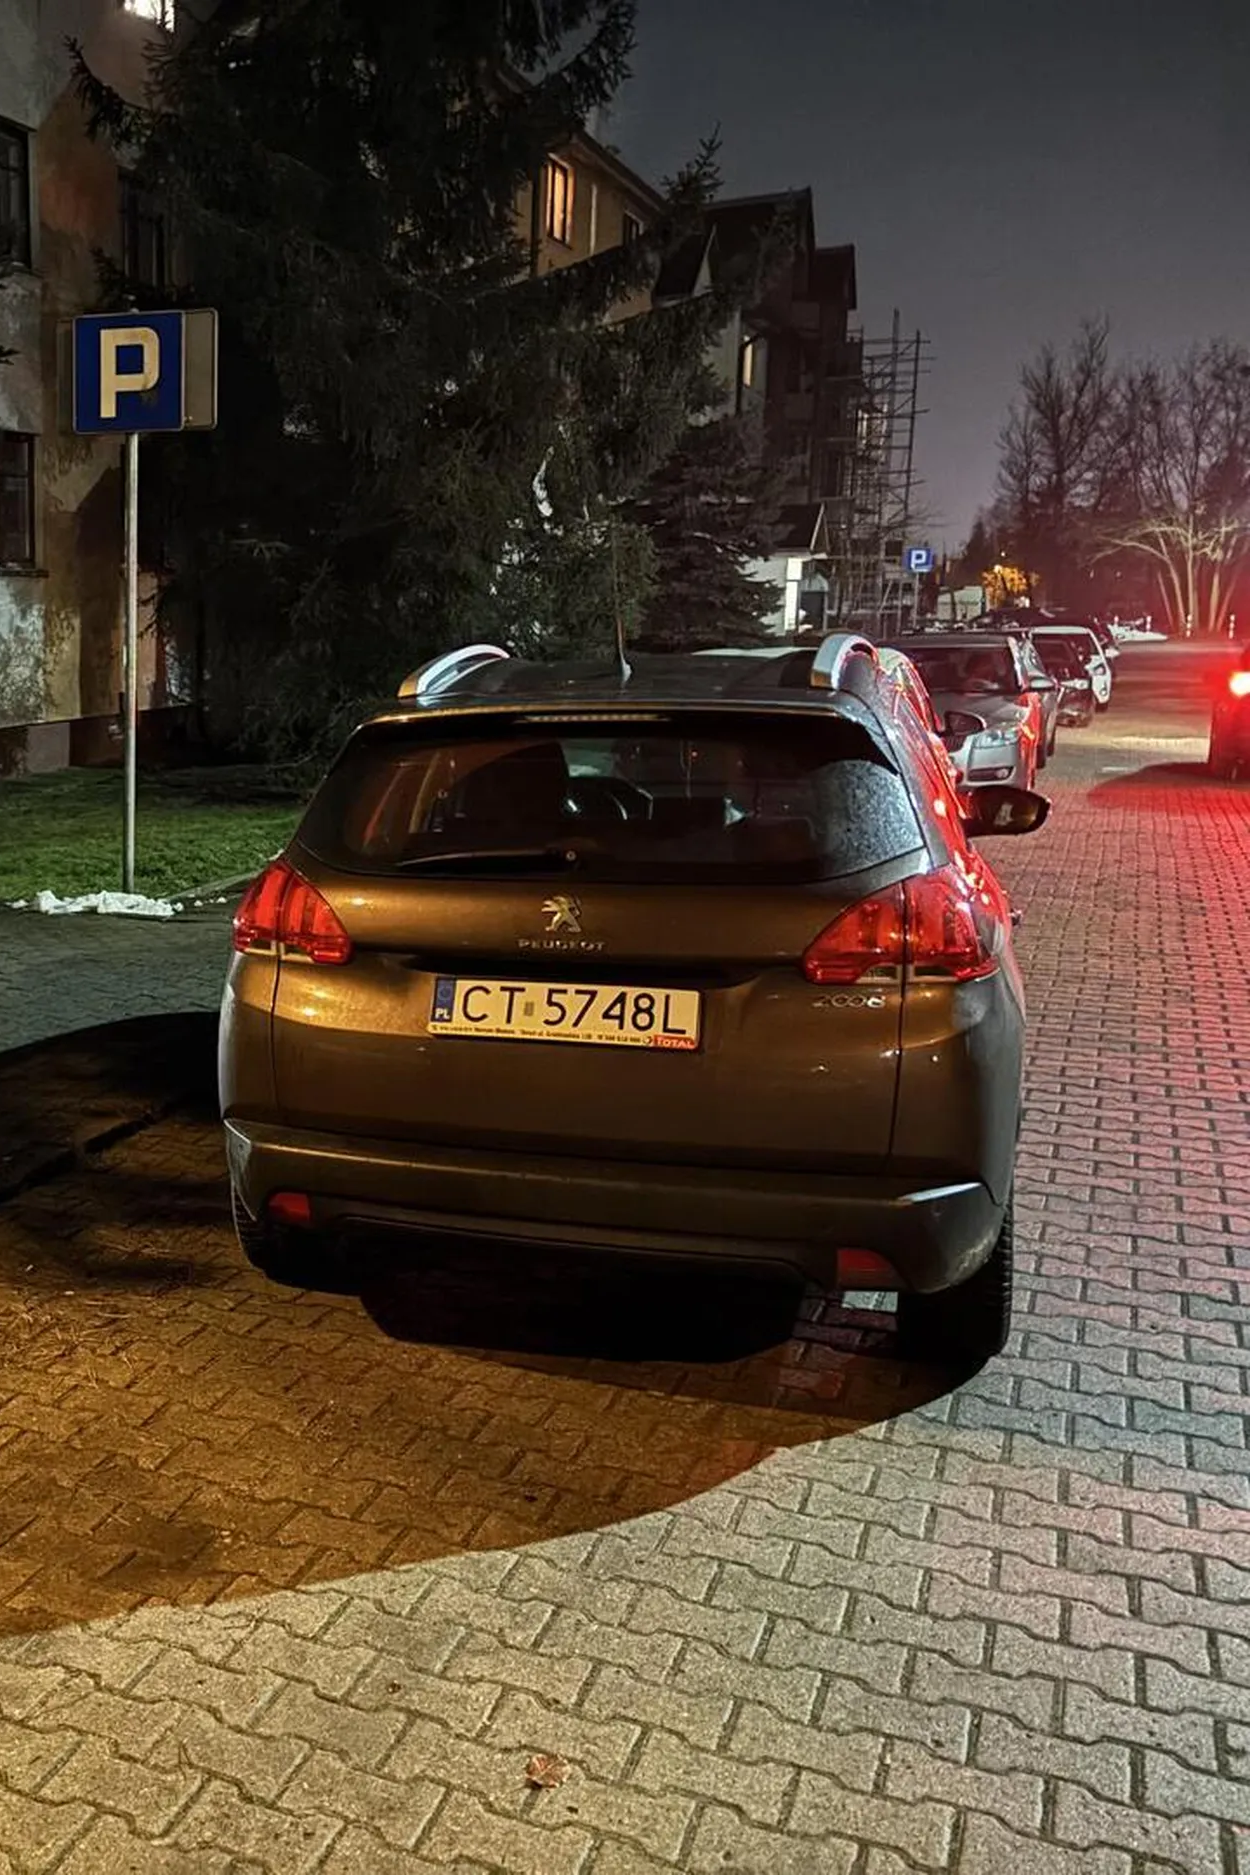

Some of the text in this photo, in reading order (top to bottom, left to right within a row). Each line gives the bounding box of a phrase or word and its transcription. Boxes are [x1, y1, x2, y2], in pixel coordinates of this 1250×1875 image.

[100, 327, 160, 418] P
[911, 550, 927, 569] P
[517, 940, 606, 951] PEUGEOT
[812, 993, 886, 1008] 2008
[435, 1008, 450, 1019] PL
[462, 985, 526, 1024] CT
[543, 988, 687, 1035] 5748L
[655, 1037, 694, 1049] TOTAL
